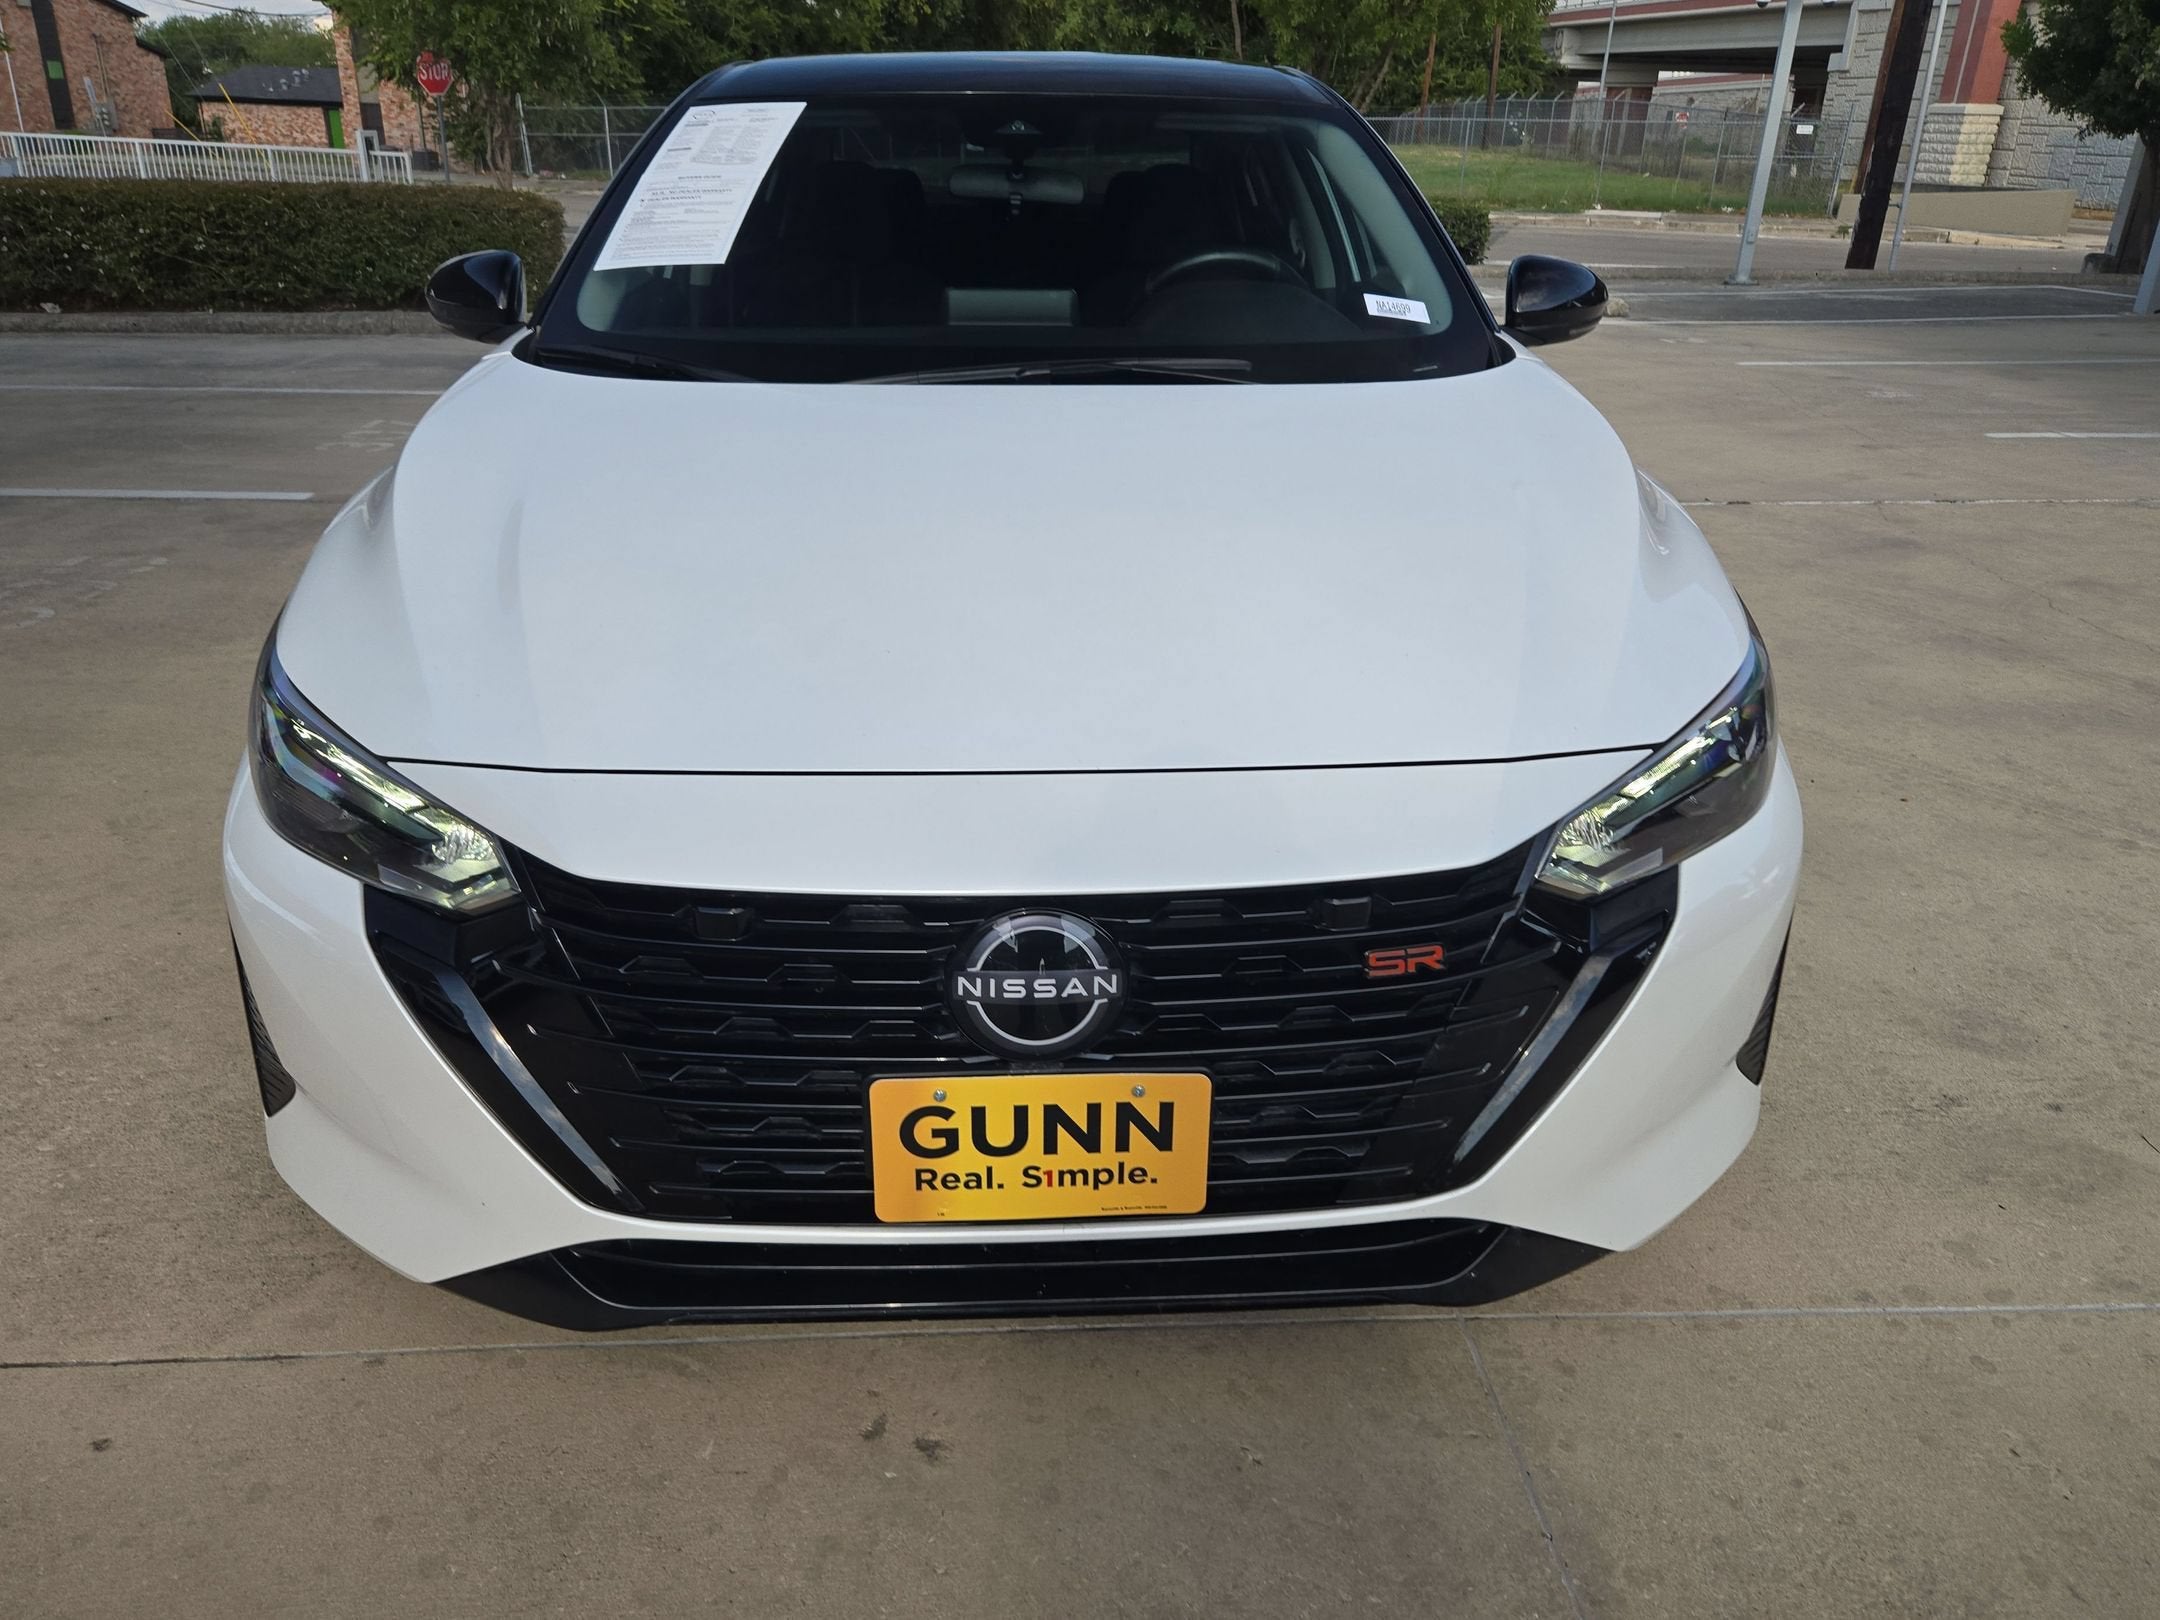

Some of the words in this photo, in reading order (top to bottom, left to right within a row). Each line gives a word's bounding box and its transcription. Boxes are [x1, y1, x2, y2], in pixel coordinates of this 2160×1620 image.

[419, 62, 449, 81] STOP
[1364, 944, 1446, 978] SR
[957, 974, 1119, 1000] NISSAN
[899, 1101, 1175, 1159] GUNN
[914, 1165, 1005, 1191] Real.
[1022, 1160, 1158, 1190] S1mple.
